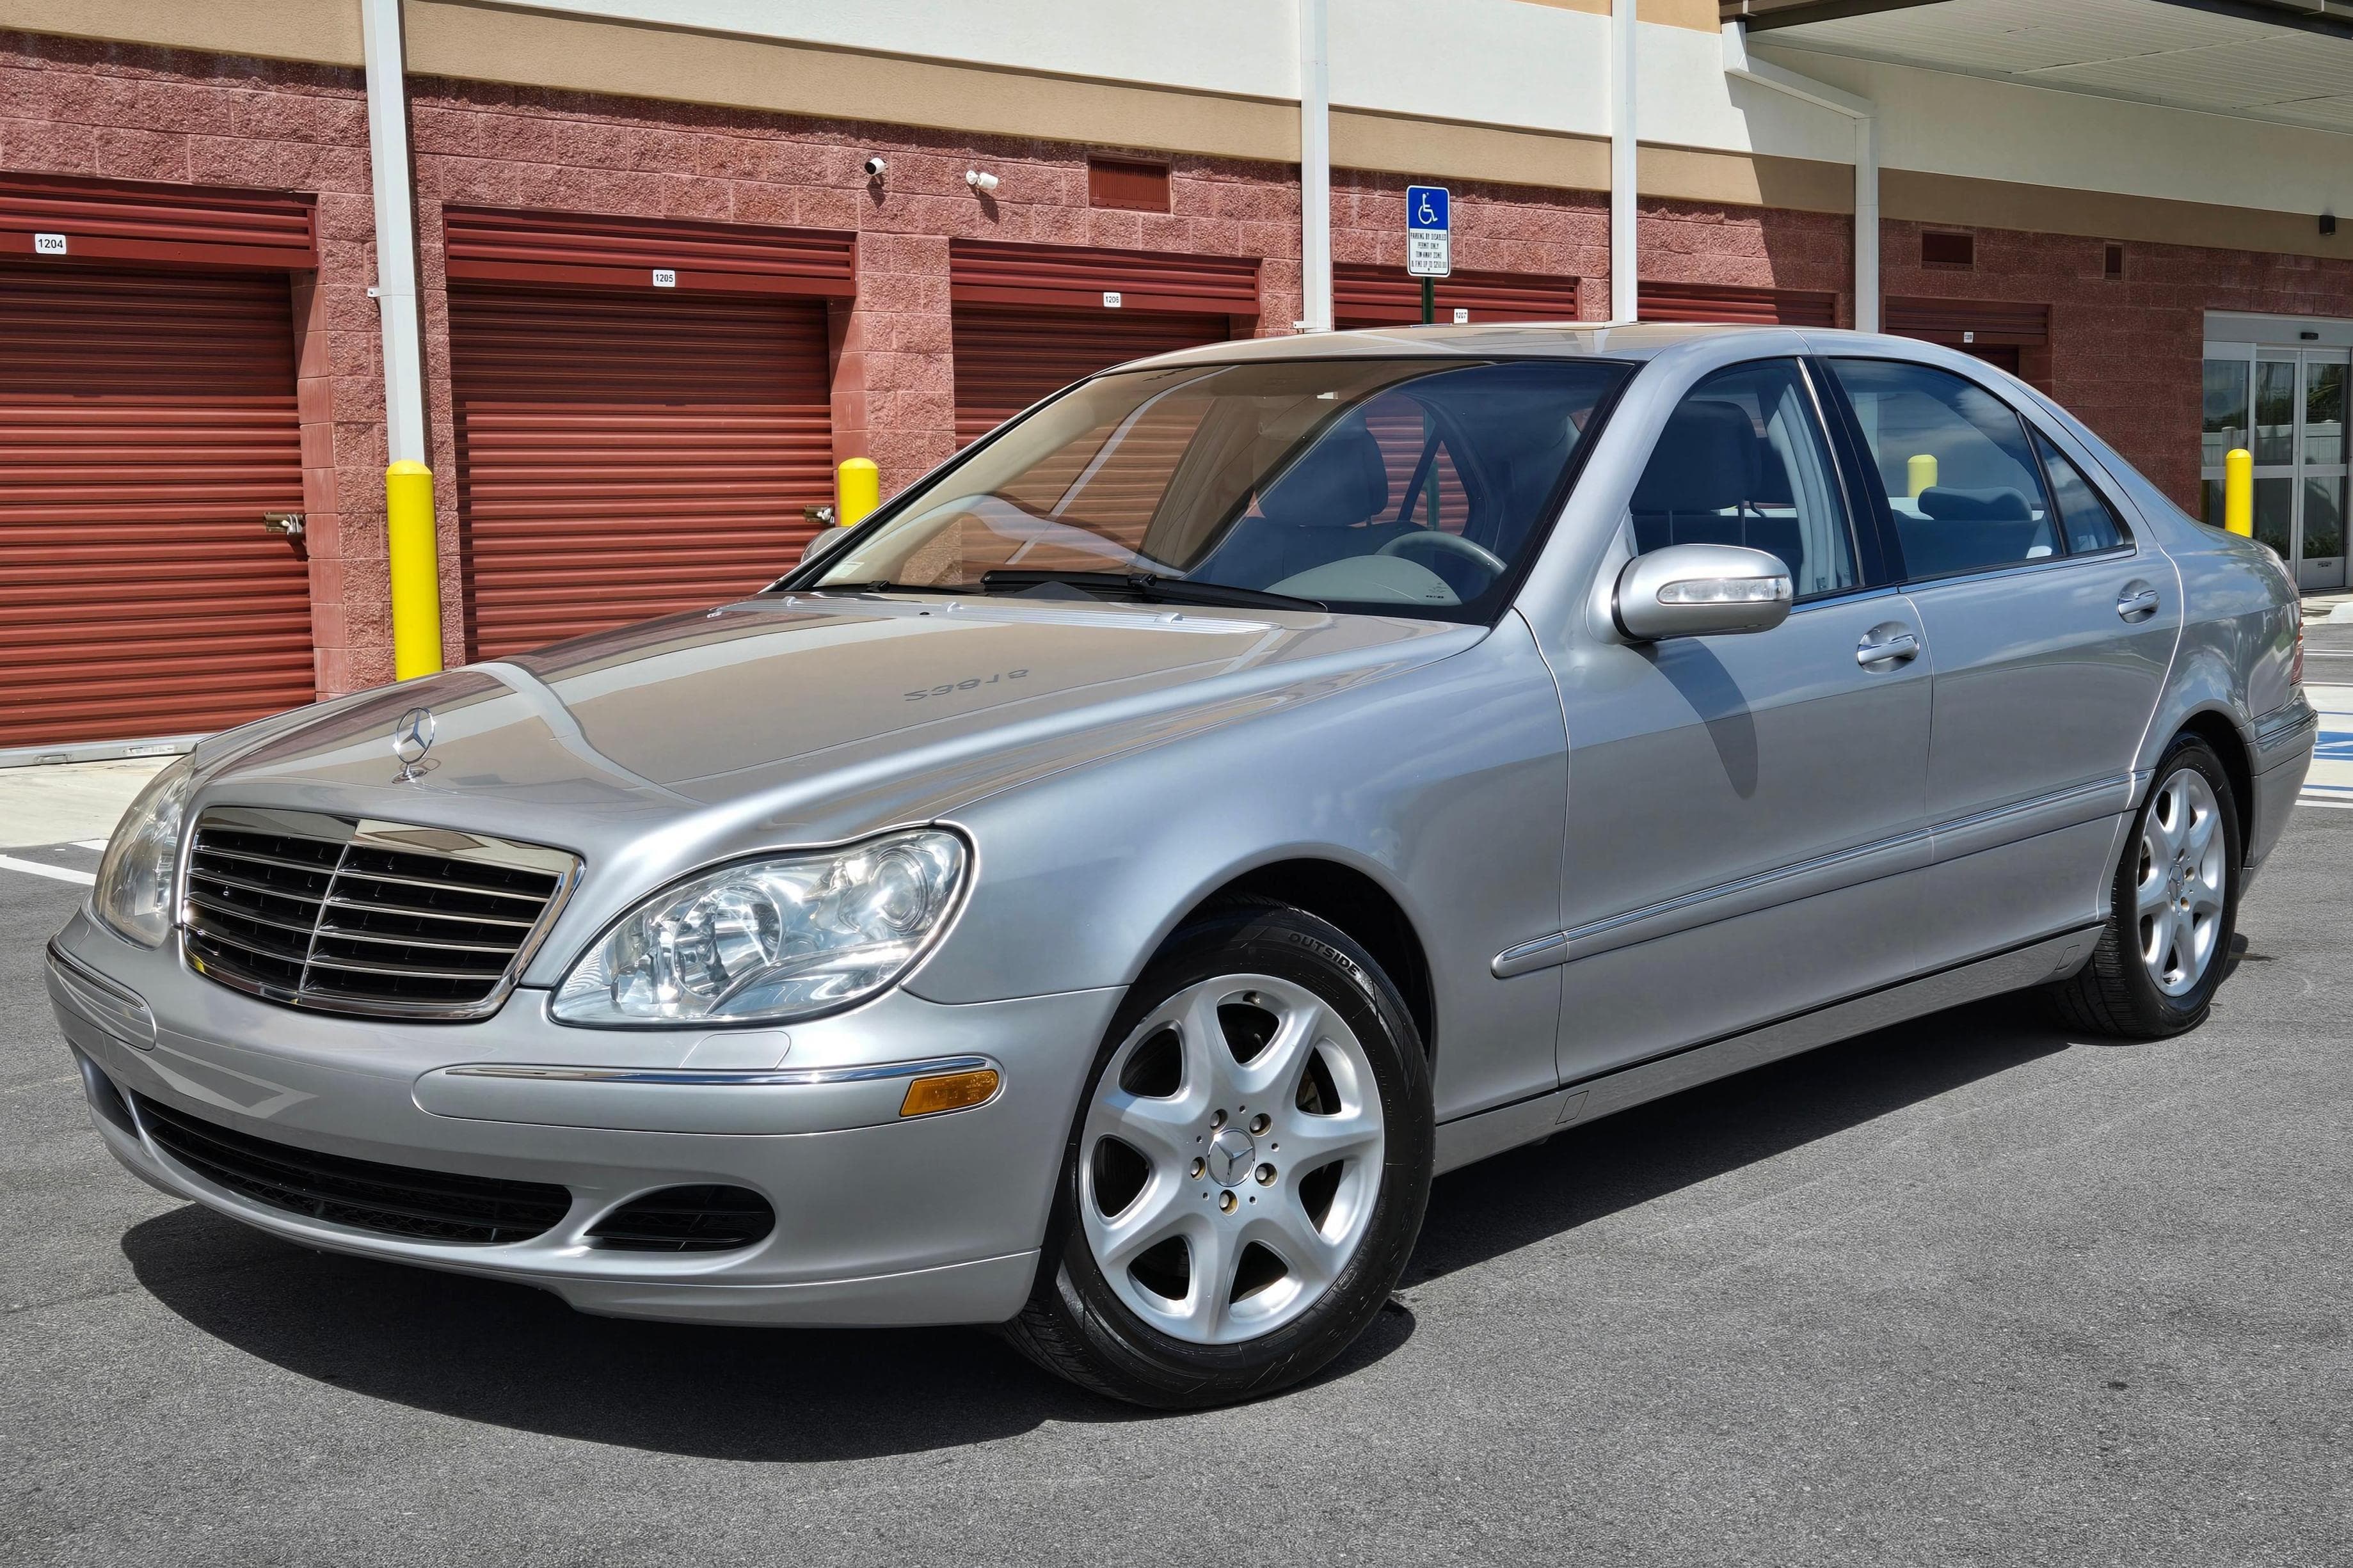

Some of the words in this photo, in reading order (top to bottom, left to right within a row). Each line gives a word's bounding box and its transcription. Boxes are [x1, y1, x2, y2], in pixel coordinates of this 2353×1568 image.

[38, 239, 63, 248] 1204
[656, 274, 674, 282] 1205
[1289, 932, 1360, 976] OUTSIDE
